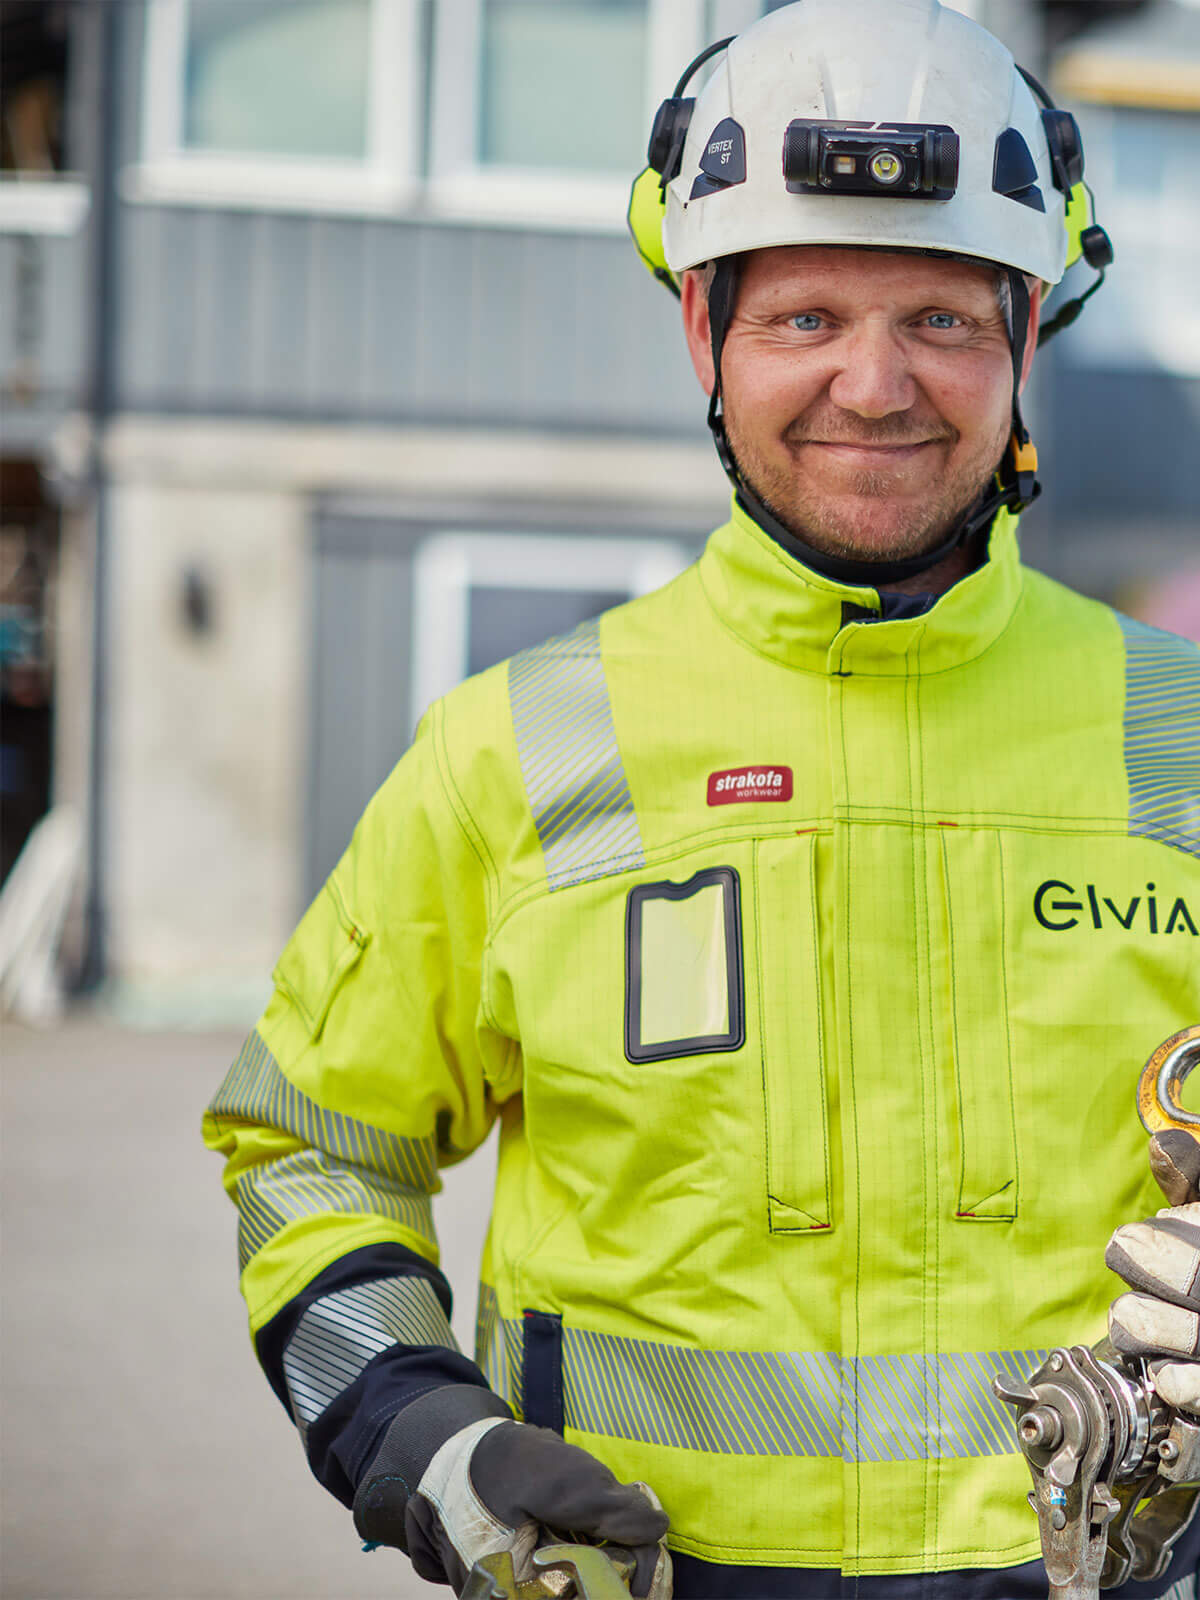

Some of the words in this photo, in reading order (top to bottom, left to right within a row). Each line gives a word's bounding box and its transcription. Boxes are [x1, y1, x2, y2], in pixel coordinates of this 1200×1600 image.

[720, 152, 731, 165] ST
[715, 770, 783, 792] strakofa
[736, 787, 783, 798] workwear
[1033, 879, 1200, 936] Elvia
